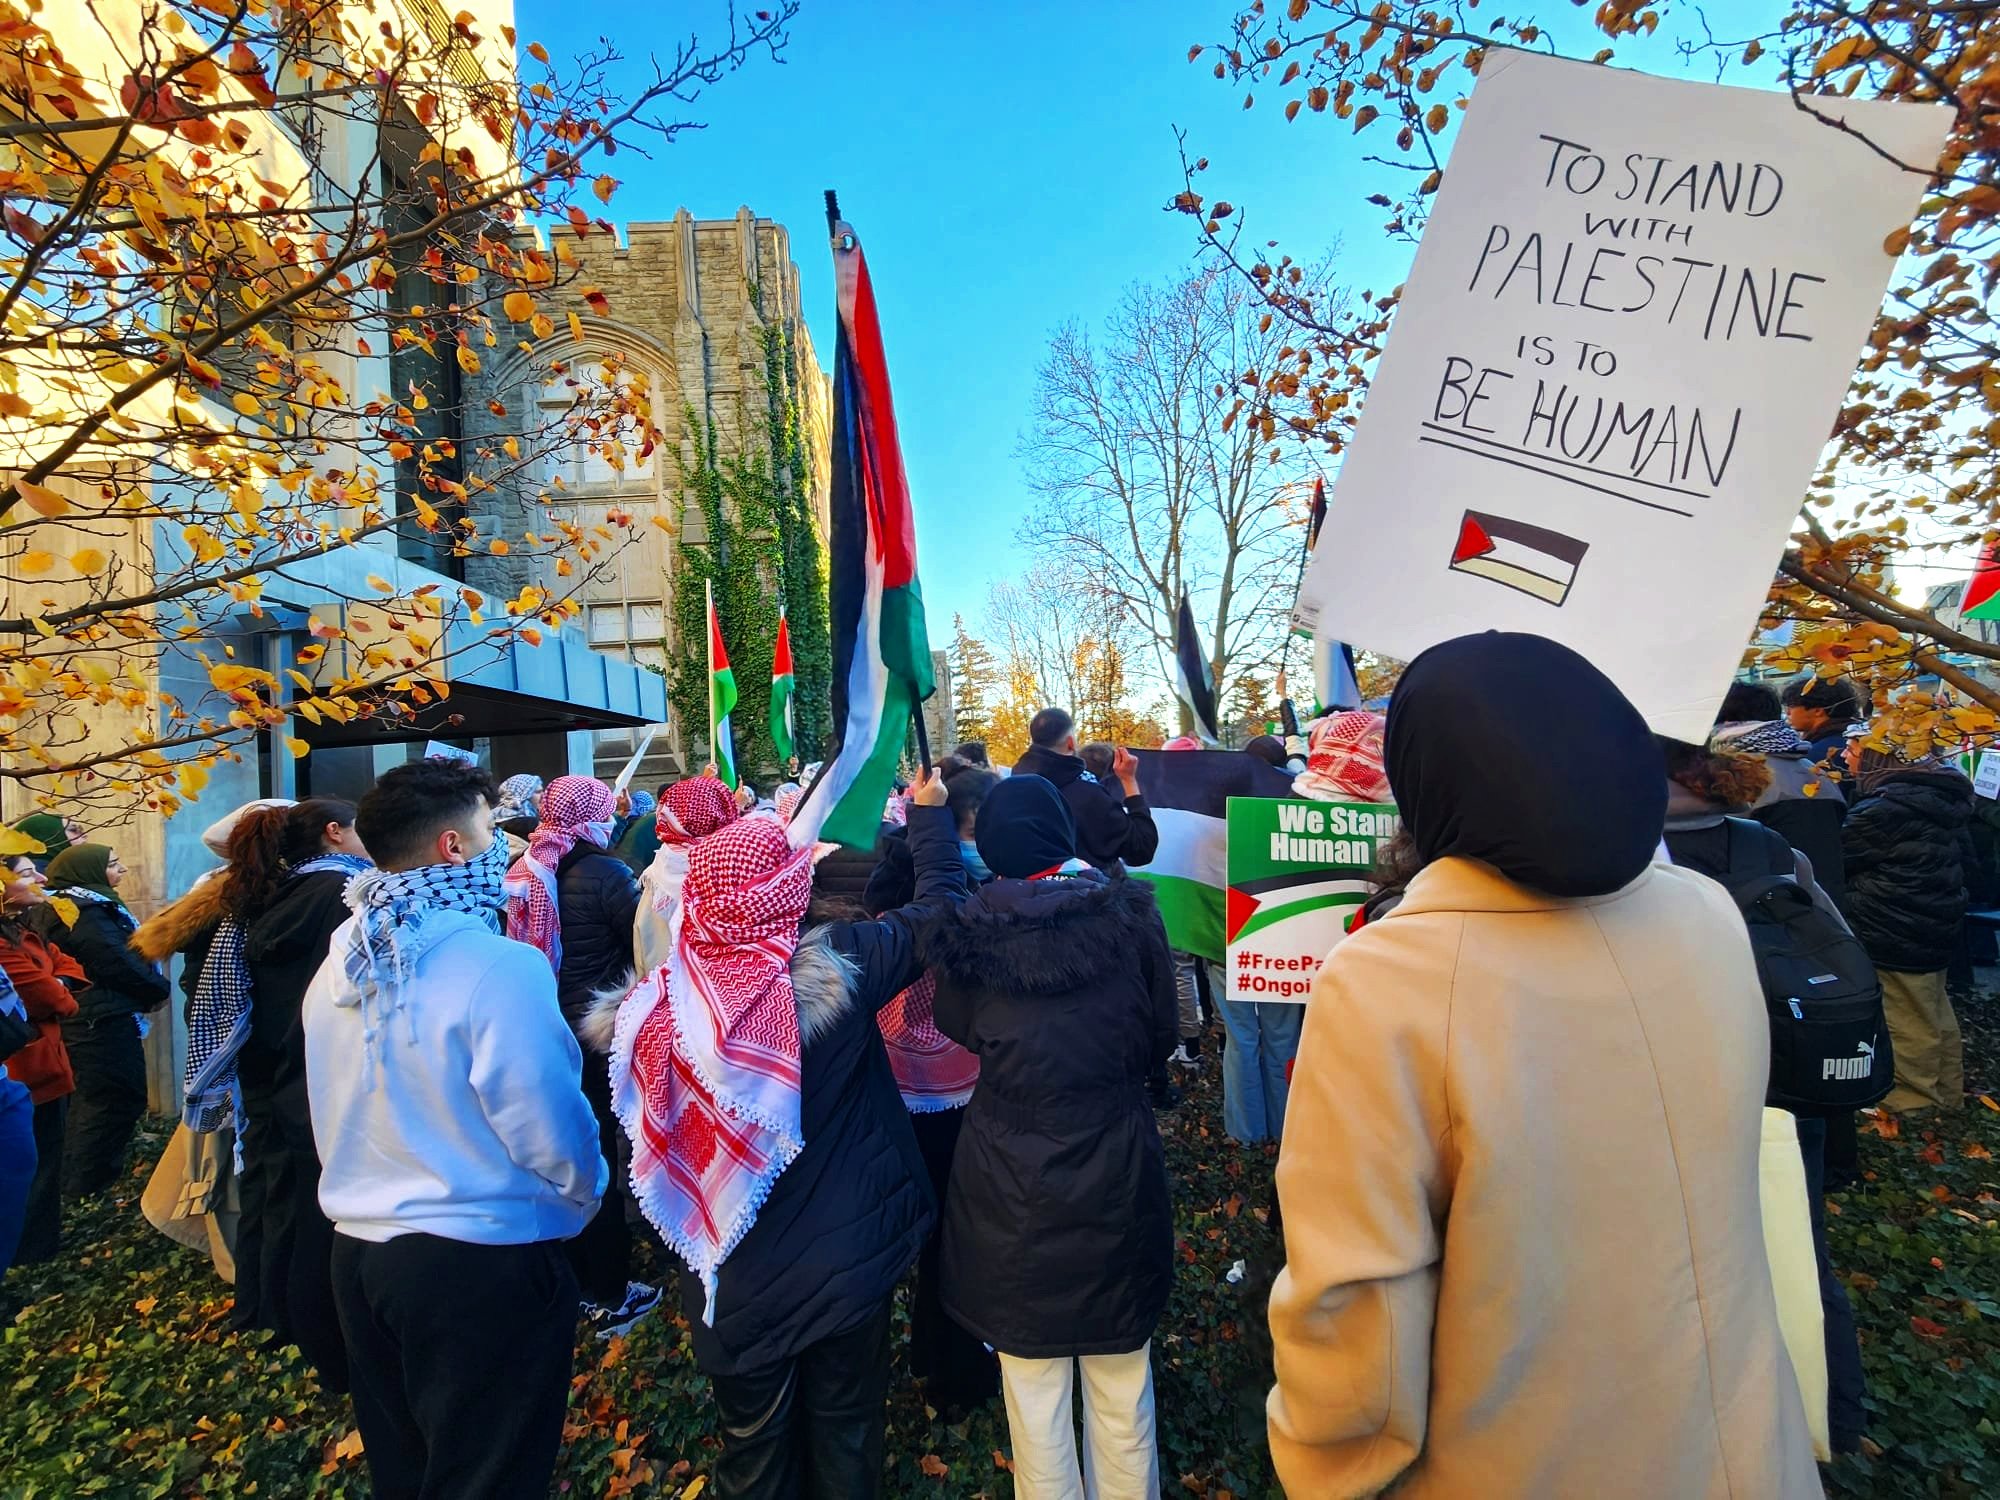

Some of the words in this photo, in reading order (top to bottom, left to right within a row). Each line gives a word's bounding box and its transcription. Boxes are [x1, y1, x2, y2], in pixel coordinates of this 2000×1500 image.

[1539, 134, 1606, 195] TO
[1615, 153, 1784, 217] STAND
[1585, 212, 1694, 246] WITH
[1469, 224, 1827, 342] PALESTINE
[1517, 335, 1555, 366] IS
[1574, 340, 1617, 377] TO
[1433, 356, 1514, 434] BE
[1523, 379, 1742, 487] HUMAN
[1277, 804, 1325, 834] We
[1270, 832, 1370, 865] Human
[1822, 1054, 1872, 1080] PUMA
